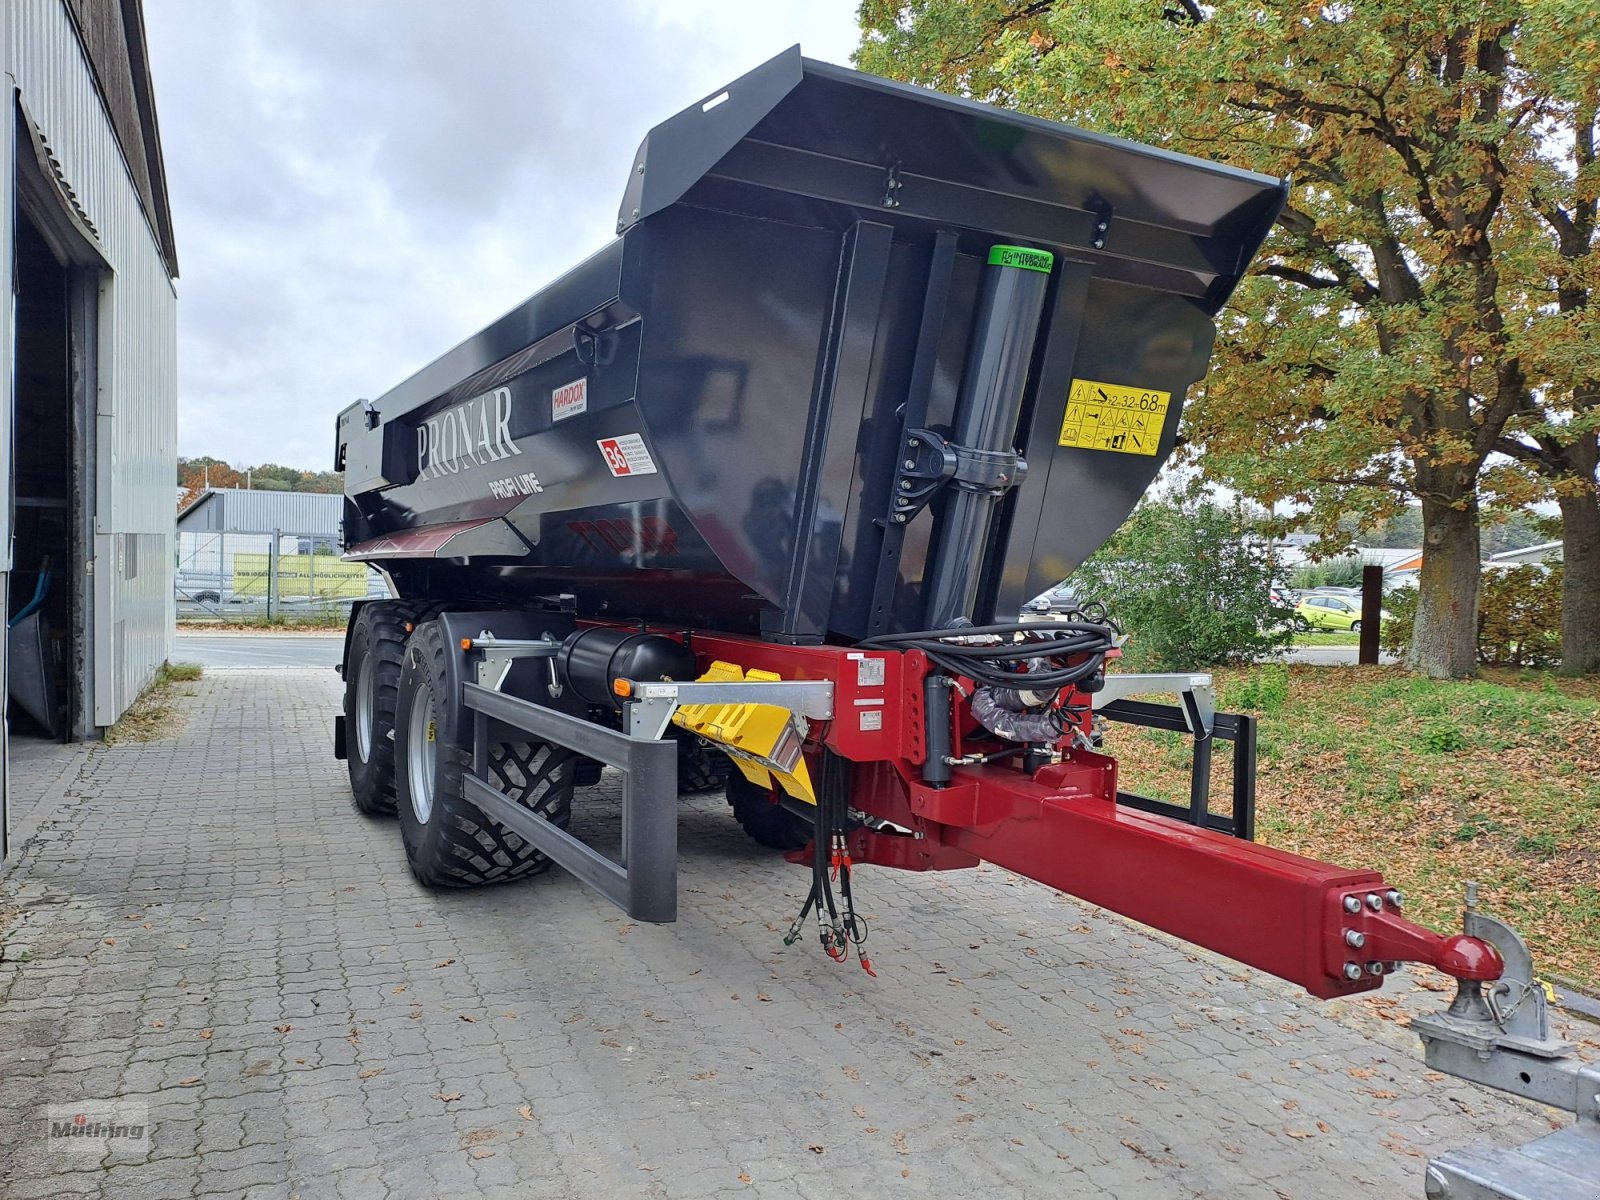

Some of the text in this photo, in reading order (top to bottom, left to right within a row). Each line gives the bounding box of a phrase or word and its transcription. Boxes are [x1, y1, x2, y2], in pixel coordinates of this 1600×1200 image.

[554, 382, 584, 409] HARDOX
[417, 386, 522, 481] PRONAR
[605, 446, 628, 469] 36
[488, 472, 544, 500] PROFI LINE
